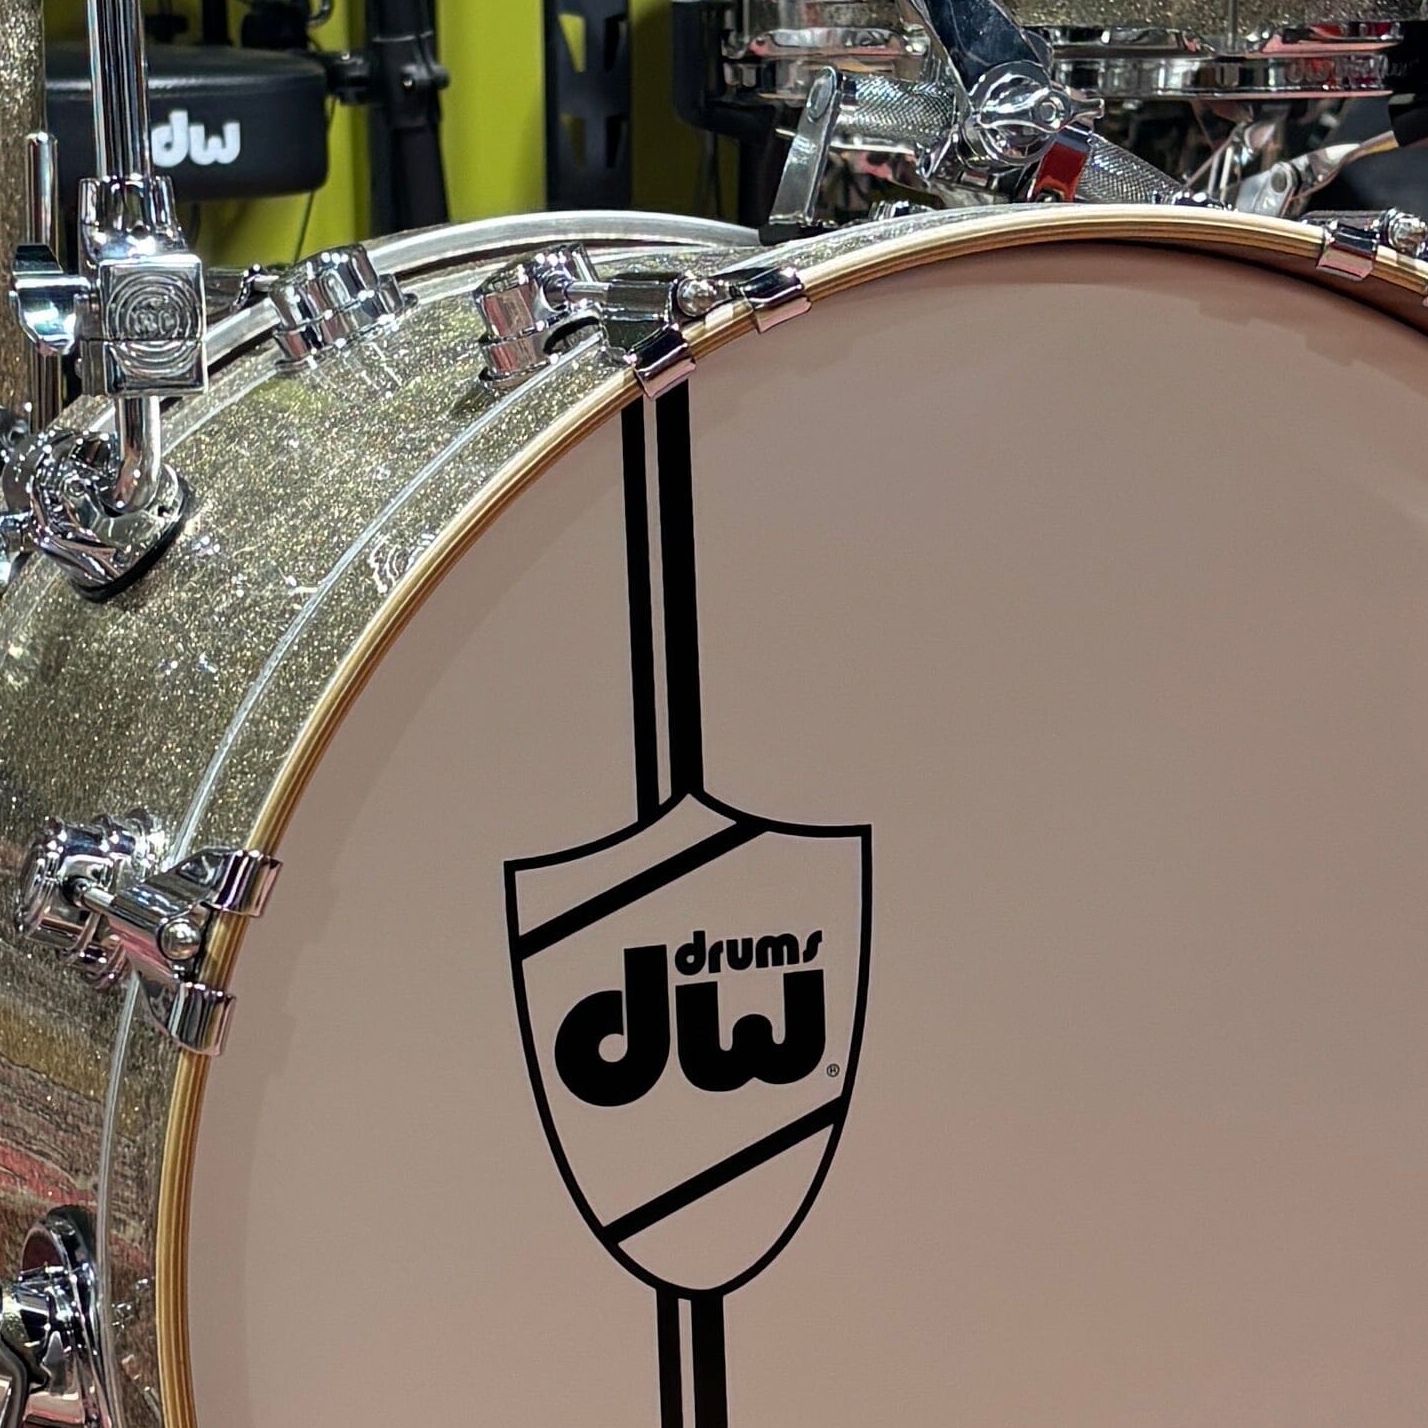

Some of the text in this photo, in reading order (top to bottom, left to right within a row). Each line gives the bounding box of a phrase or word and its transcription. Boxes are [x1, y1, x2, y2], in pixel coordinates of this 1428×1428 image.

[151, 110, 241, 168] dw
[674, 929, 823, 976] drums
[554, 943, 827, 1108] dw
